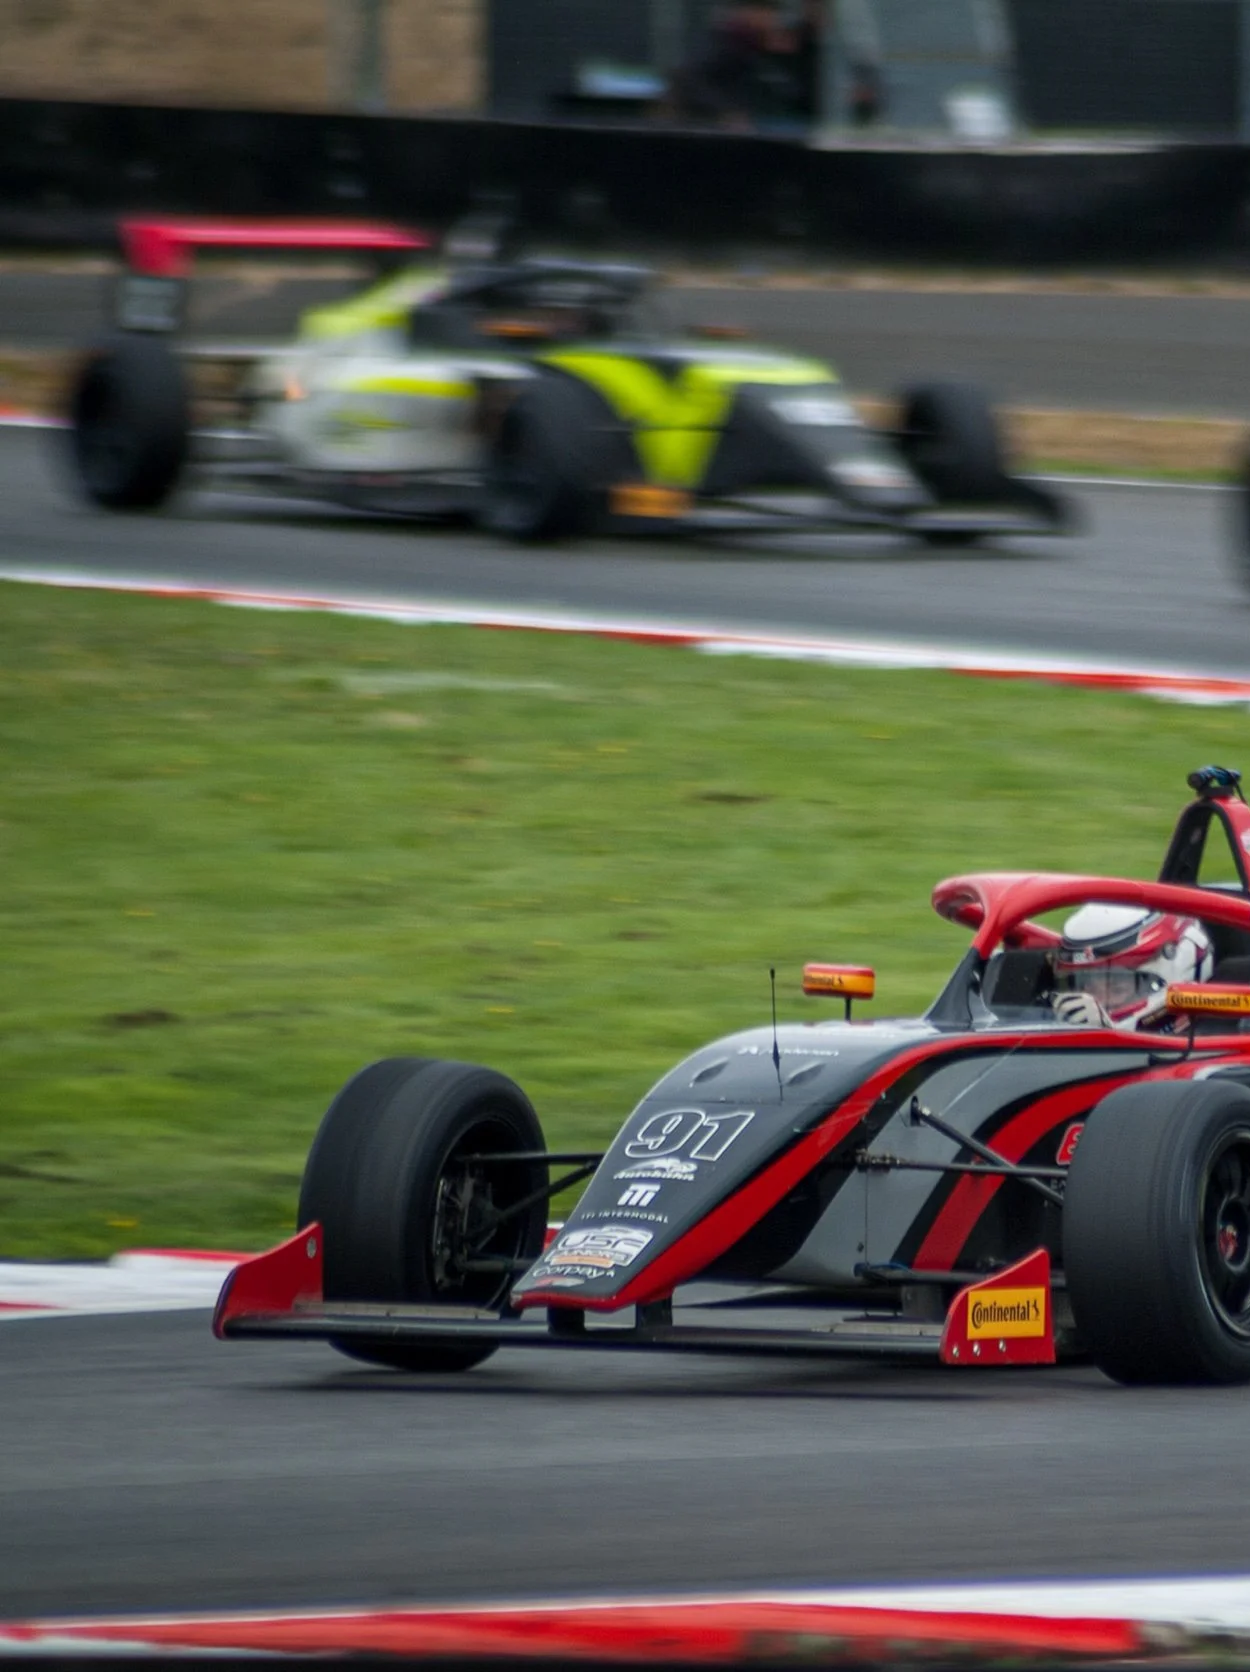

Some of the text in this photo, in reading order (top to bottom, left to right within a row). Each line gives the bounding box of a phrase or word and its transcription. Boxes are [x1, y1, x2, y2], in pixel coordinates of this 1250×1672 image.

[1171, 994, 1240, 1007] Continental
[625, 1108, 755, 1161] 91
[598, 1209, 669, 1224] INTERMODAL
[561, 1232, 645, 1250] USF
[971, 1300, 1030, 1329] Continental
